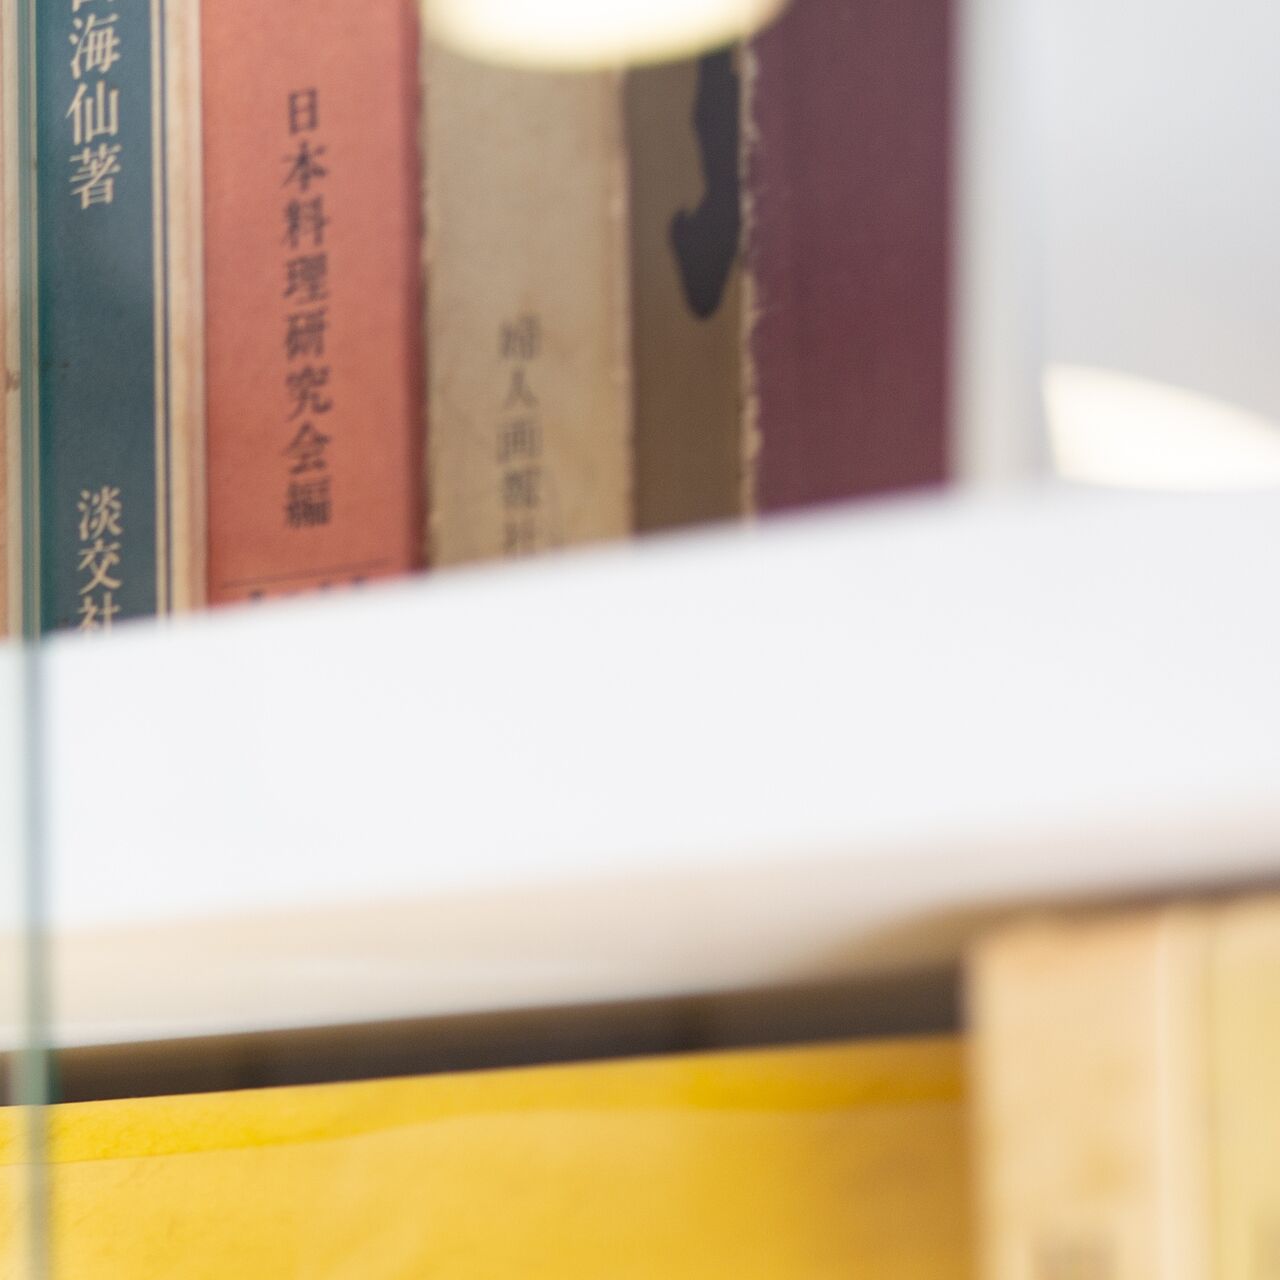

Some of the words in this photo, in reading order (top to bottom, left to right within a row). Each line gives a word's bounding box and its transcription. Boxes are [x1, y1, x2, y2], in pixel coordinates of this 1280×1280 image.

[65, 0, 122, 210] 海仙著
[280, 87, 333, 530] 日本料理研究会編
[77, 484, 124, 637] 淡交社
